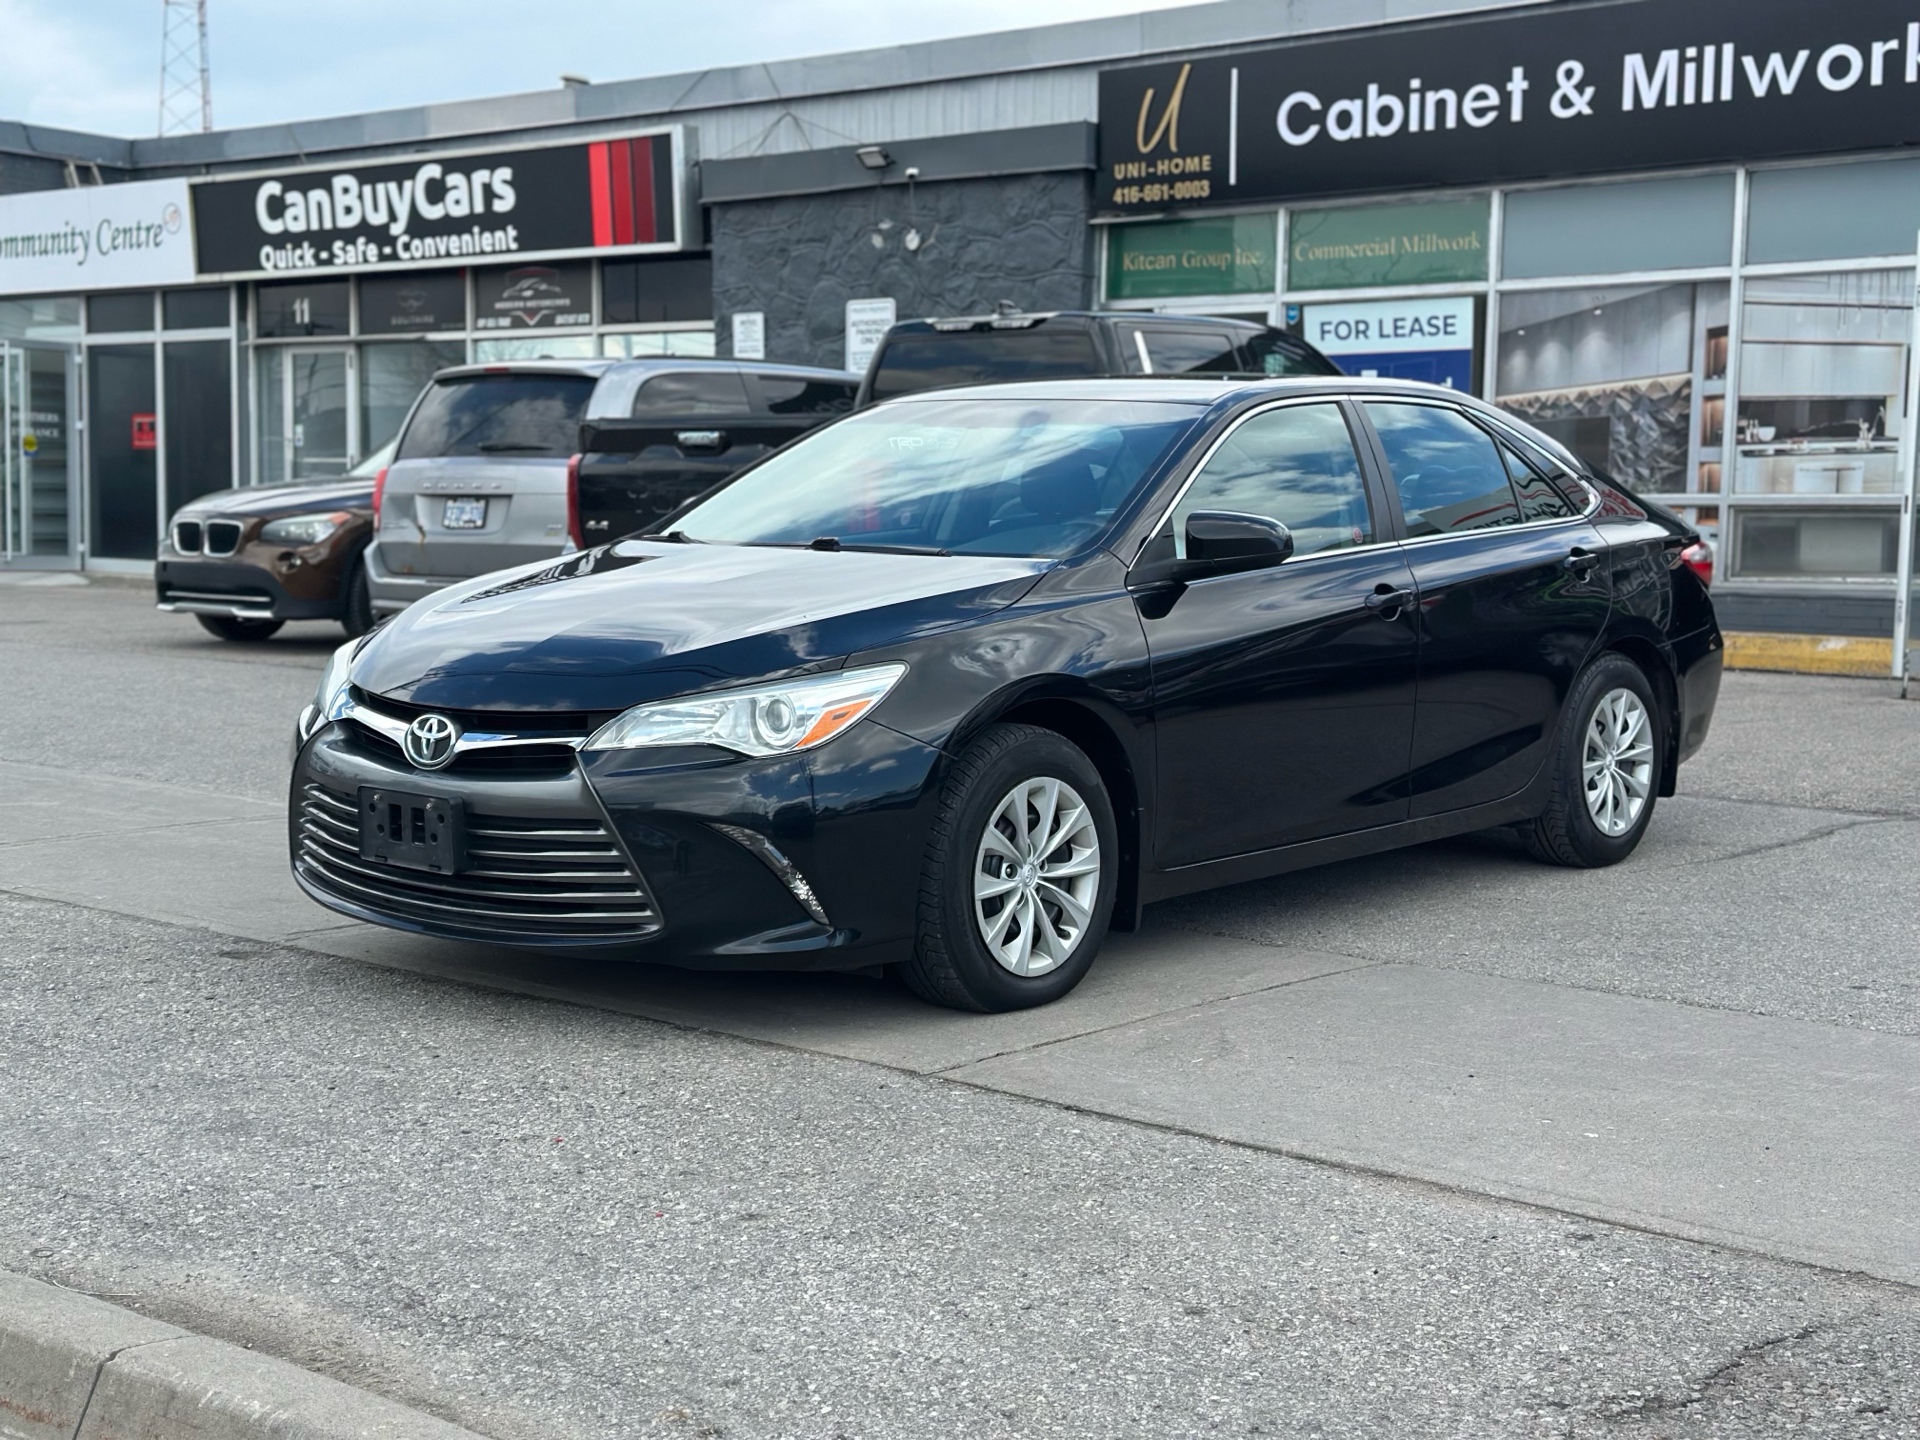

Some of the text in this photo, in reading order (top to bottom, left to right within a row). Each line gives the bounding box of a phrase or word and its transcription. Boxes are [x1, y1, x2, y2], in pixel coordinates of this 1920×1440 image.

[1276, 65, 1530, 147] Cabinet
[1549, 59, 1596, 119] &
[1113, 154, 1212, 180] UNI-HOME
[255, 162, 517, 236] CanBuyCars
[1112, 179, 1211, 204] 416-661-0003
[96, 217, 164, 257] Centre
[259, 240, 317, 272] Quick
[332, 235, 379, 266] Safe
[396, 224, 519, 261] Convenient
[1294, 231, 1482, 262] Commercial Millwork
[1122, 251, 1177, 272] Kitcan
[1181, 248, 1232, 271] Group
[293, 298, 311, 324] 11
[1320, 315, 1457, 342] FOR LEASE
[888, 436, 924, 450] TRD
